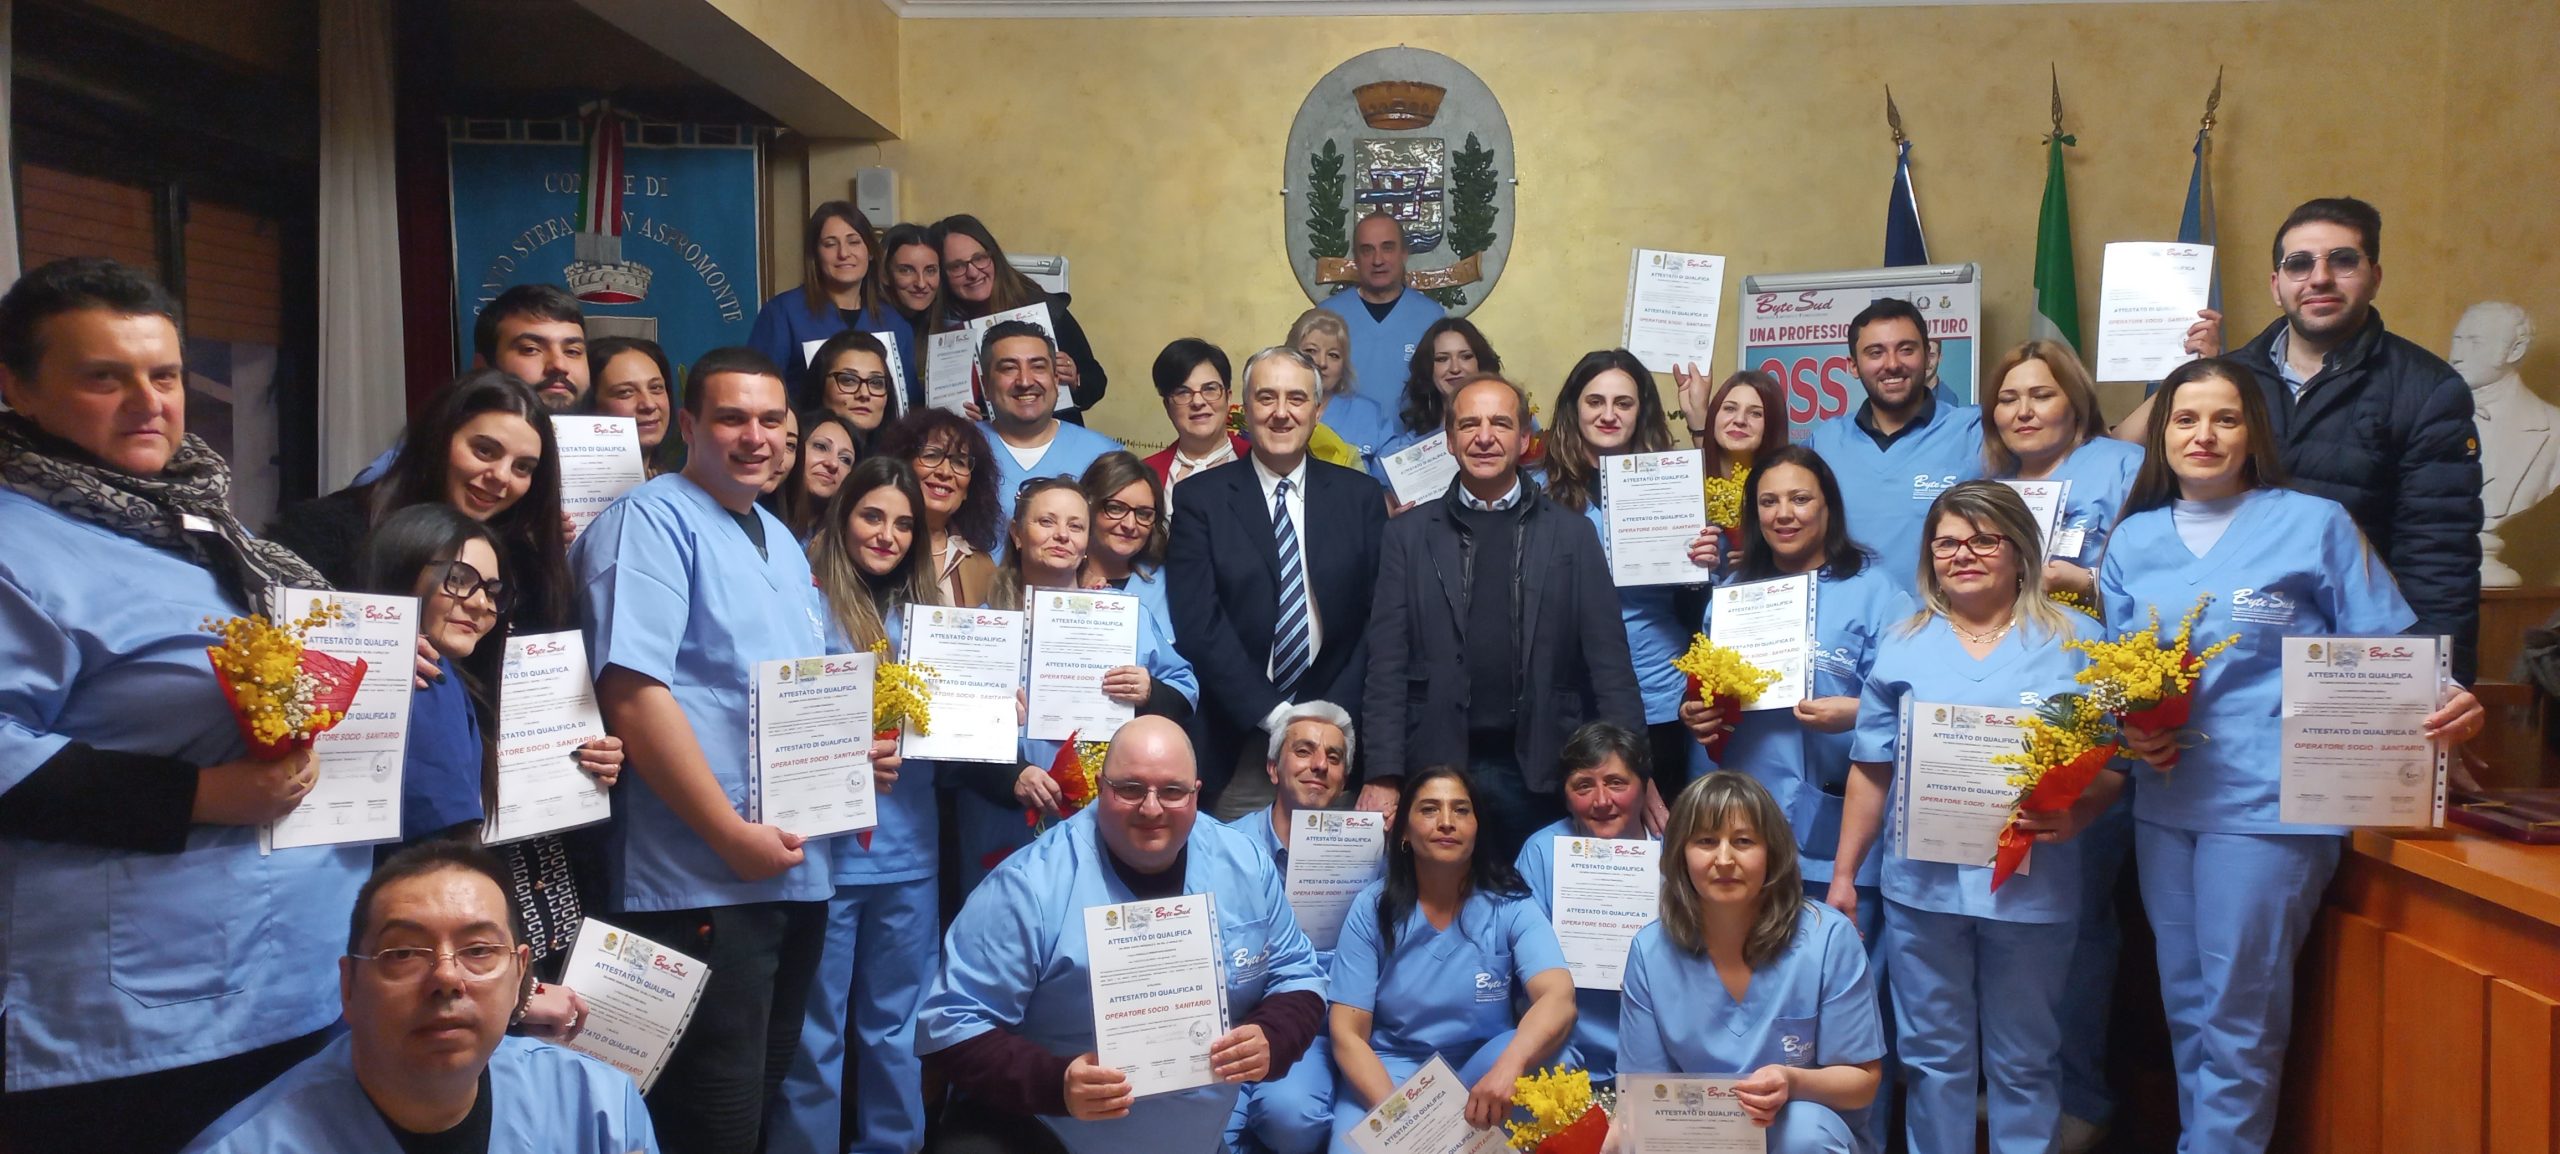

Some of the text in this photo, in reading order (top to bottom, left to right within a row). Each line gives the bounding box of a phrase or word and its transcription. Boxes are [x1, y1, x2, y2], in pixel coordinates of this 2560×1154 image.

[545, 174, 668, 197] COE DI
[512, 213, 576, 257] STEFA
[638, 218, 743, 323] ASPROMONTE
[1756, 290, 1834, 316] Byte Sud
[1750, 318, 1968, 342] UNA PROFESSIO UTURO
[1913, 474, 1939, 491] Byte
[2232, 588, 2295, 609] Byte Sud
[365, 605, 401, 622] Byte Sud
[309, 636, 399, 647] ATTESTATO DI QUALIFICA
[525, 641, 566, 657] Byte Sud
[521, 670, 529, 678] DI
[529, 665, 569, 677] QUALIFICA
[825, 661, 858, 674] Byte Sud
[779, 689, 815, 698] ATTESTATO
[824, 685, 857, 694] QUALIFICA
[355, 712, 388, 720] QUALIFICA
[389, 712, 396, 720] DI
[316, 732, 400, 742] ATORE SOCIO SANITARIO
[501, 730, 526, 740] STATO
[528, 728, 535, 736] DI
[536, 723, 577, 735] QUALIFICA
[1984, 736, 2019, 744] QUALIFICA
[499, 735, 598, 757] ATORE SOCIO SANITARIO
[776, 743, 811, 753] ATTESTATO
[820, 738, 853, 747] QUALIFICA
[2294, 743, 2343, 751] OPERATORE
[770, 750, 866, 769] OPERATORE SOCIO SANITARIO
[1926, 784, 1967, 792] ATTESTATO
[1977, 788, 2013, 797] QUALIFICA
[1920, 796, 1961, 805] OPERATORE
[1964, 800, 1985, 808] SOCIO
[1155, 904, 1191, 919] Byte Sud
[1561, 920, 1596, 928] OPERATORE
[1108, 934, 1147, 945] ATTESTATO
[1156, 929, 1192, 940] QUALIFICA
[654, 954, 688, 978] Byte Sud
[1233, 948, 1260, 968] Byte
[595, 961, 675, 1000] ATTESTATO DI QUALIFICA
[1475, 972, 1500, 989] Byte
[1109, 992, 1148, 1004] ATTESTATO
[1158, 987, 1194, 997] QUALIFICA
[1105, 999, 1211, 1020] OPERATORE SOCIO SANITARIO
[579, 1028, 648, 1058] STATO DI QUALIFICA DI
[611, 1058, 644, 1075] SANITARIO
[1405, 1074, 1435, 1101] Byte Sud
[1384, 1090, 1446, 1147] ATTESTATO DI QUALIFICA
